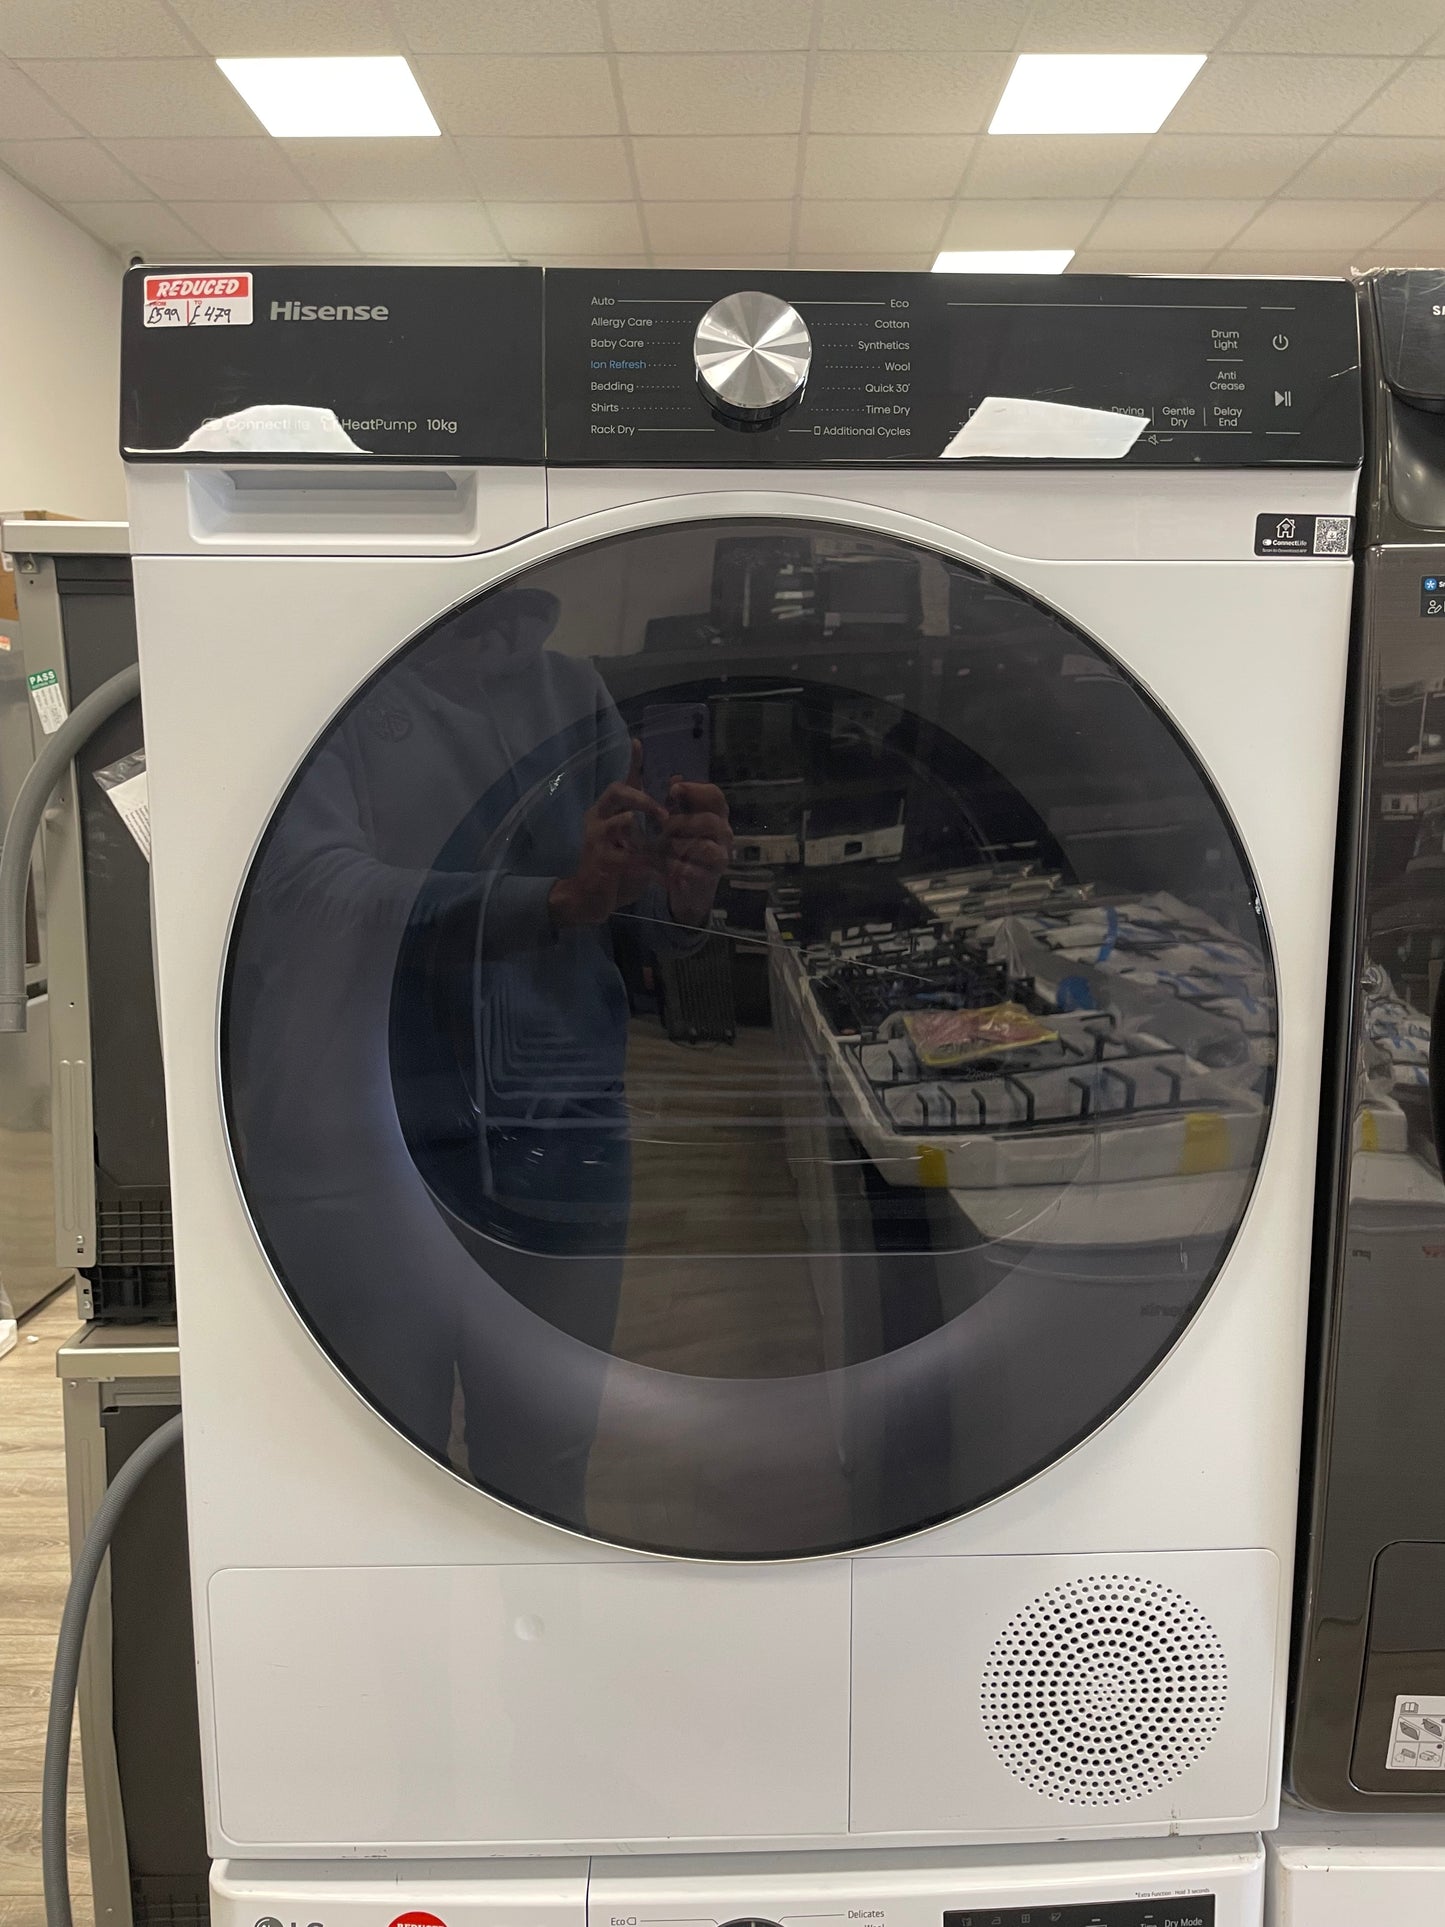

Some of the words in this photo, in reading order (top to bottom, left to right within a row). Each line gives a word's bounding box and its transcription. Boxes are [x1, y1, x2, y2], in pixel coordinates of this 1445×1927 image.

[156, 279, 240, 298] REDUCED
[590, 296, 615, 306] Auto
[890, 299, 910, 308] Eco
[270, 301, 389, 321] Hisense
[591, 317, 626, 329] Allergy
[627, 317, 653, 327] Care
[874, 319, 910, 329] Cotton
[1211, 329, 1240, 339] Drum
[590, 338, 617, 350] Baby
[619, 338, 645, 348] Care
[858, 340, 910, 352] Synthetics
[1214, 340, 1238, 351] Light
[590, 360, 607, 369] Ion
[609, 360, 647, 369] Refresh
[884, 361, 911, 371] Wool
[1217, 371, 1237, 380] Anti
[590, 381, 634, 393] Bedding
[865, 383, 894, 393] Quick
[1209, 381, 1246, 391] Crease
[591, 402, 620, 412] Shirts
[866, 405, 891, 415] Time
[893, 405, 911, 416] Dry
[1162, 406, 1196, 416] Gentle
[1213, 406, 1242, 418] Delay
[341, 418, 418, 433] HeatPump
[426, 418, 458, 434] 10kg
[1170, 417, 1188, 428] Dry
[1219, 417, 1238, 427] End
[590, 424, 616, 434] Rack
[617, 424, 635, 436] Dry
[823, 426, 876, 436] Additional
[877, 426, 911, 438] Cycles
[29, 670, 56, 686] PASS
[848, 1910, 885, 1919] Delicates
[610, 1917, 626, 1926] Eco
[1180, 1917, 1203, 1927] Mode
